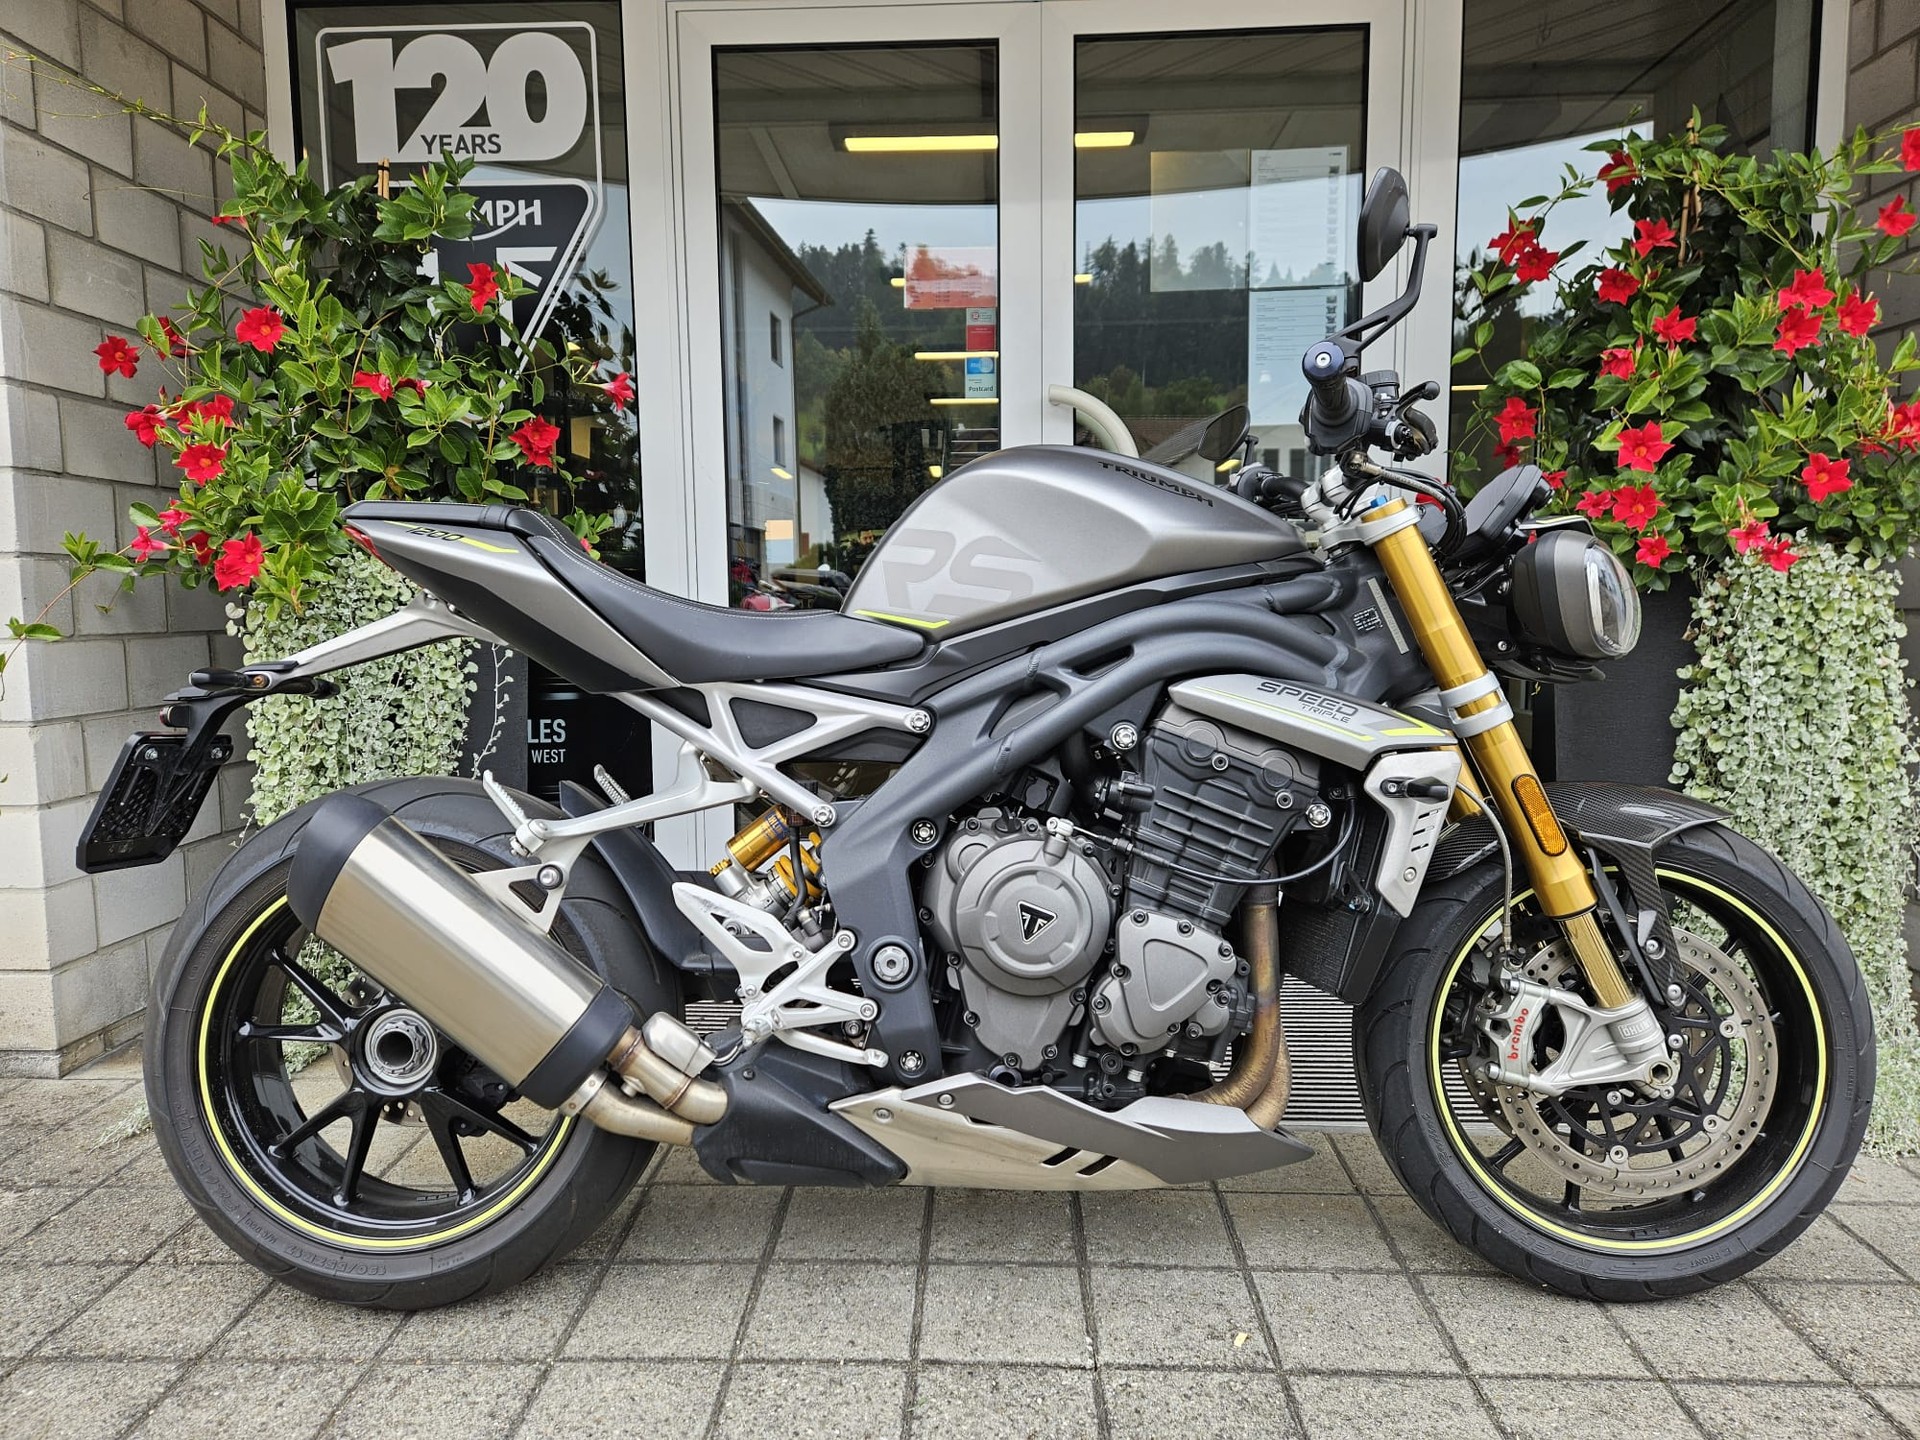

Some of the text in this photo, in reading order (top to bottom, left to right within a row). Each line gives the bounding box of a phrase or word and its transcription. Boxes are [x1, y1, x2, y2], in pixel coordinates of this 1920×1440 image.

[326, 32, 588, 164] 120
[420, 134, 502, 155] YEARS
[1098, 461, 1214, 507] TRIUMPH
[406, 526, 465, 542] 1200
[882, 528, 1044, 618] RS
[1257, 681, 1359, 717] SPEED
[1301, 703, 1351, 724] TRIPLE
[531, 749, 566, 763] WEST
[1507, 1008, 1529, 1060] brembo
[1455, 1181, 1593, 1269] MICHELIN
